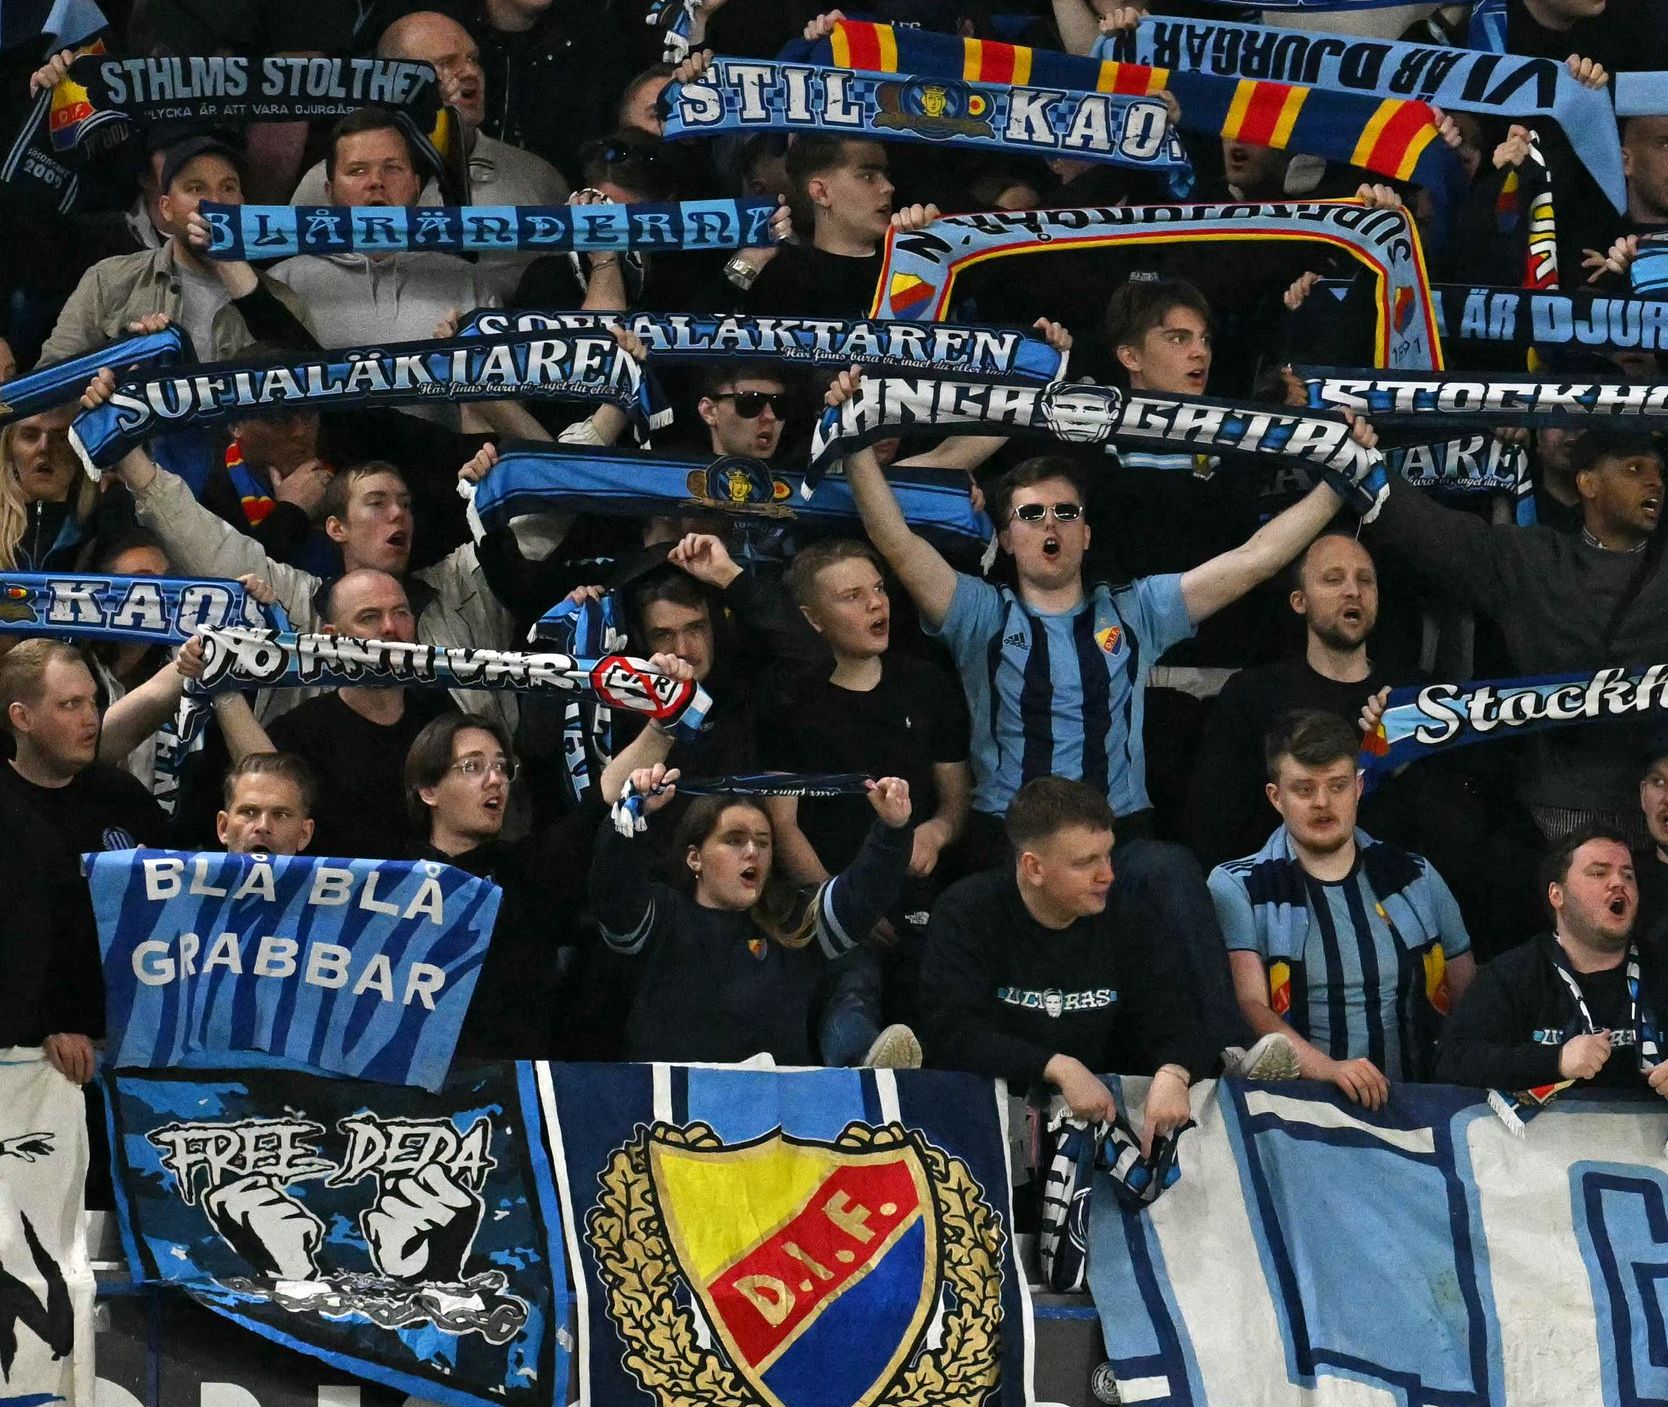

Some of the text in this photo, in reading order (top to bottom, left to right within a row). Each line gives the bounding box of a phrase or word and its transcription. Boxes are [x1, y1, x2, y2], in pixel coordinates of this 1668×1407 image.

[99, 53, 438, 109] STHLMS STOLTHET
[1002, 85, 1190, 165] KAO
[141, 850, 447, 925] BLÅ BLÅ
[131, 931, 448, 1012] GRABBAR
[148, 1119, 340, 1205] FREE
[731, 1187, 900, 1330] D.I.F.
